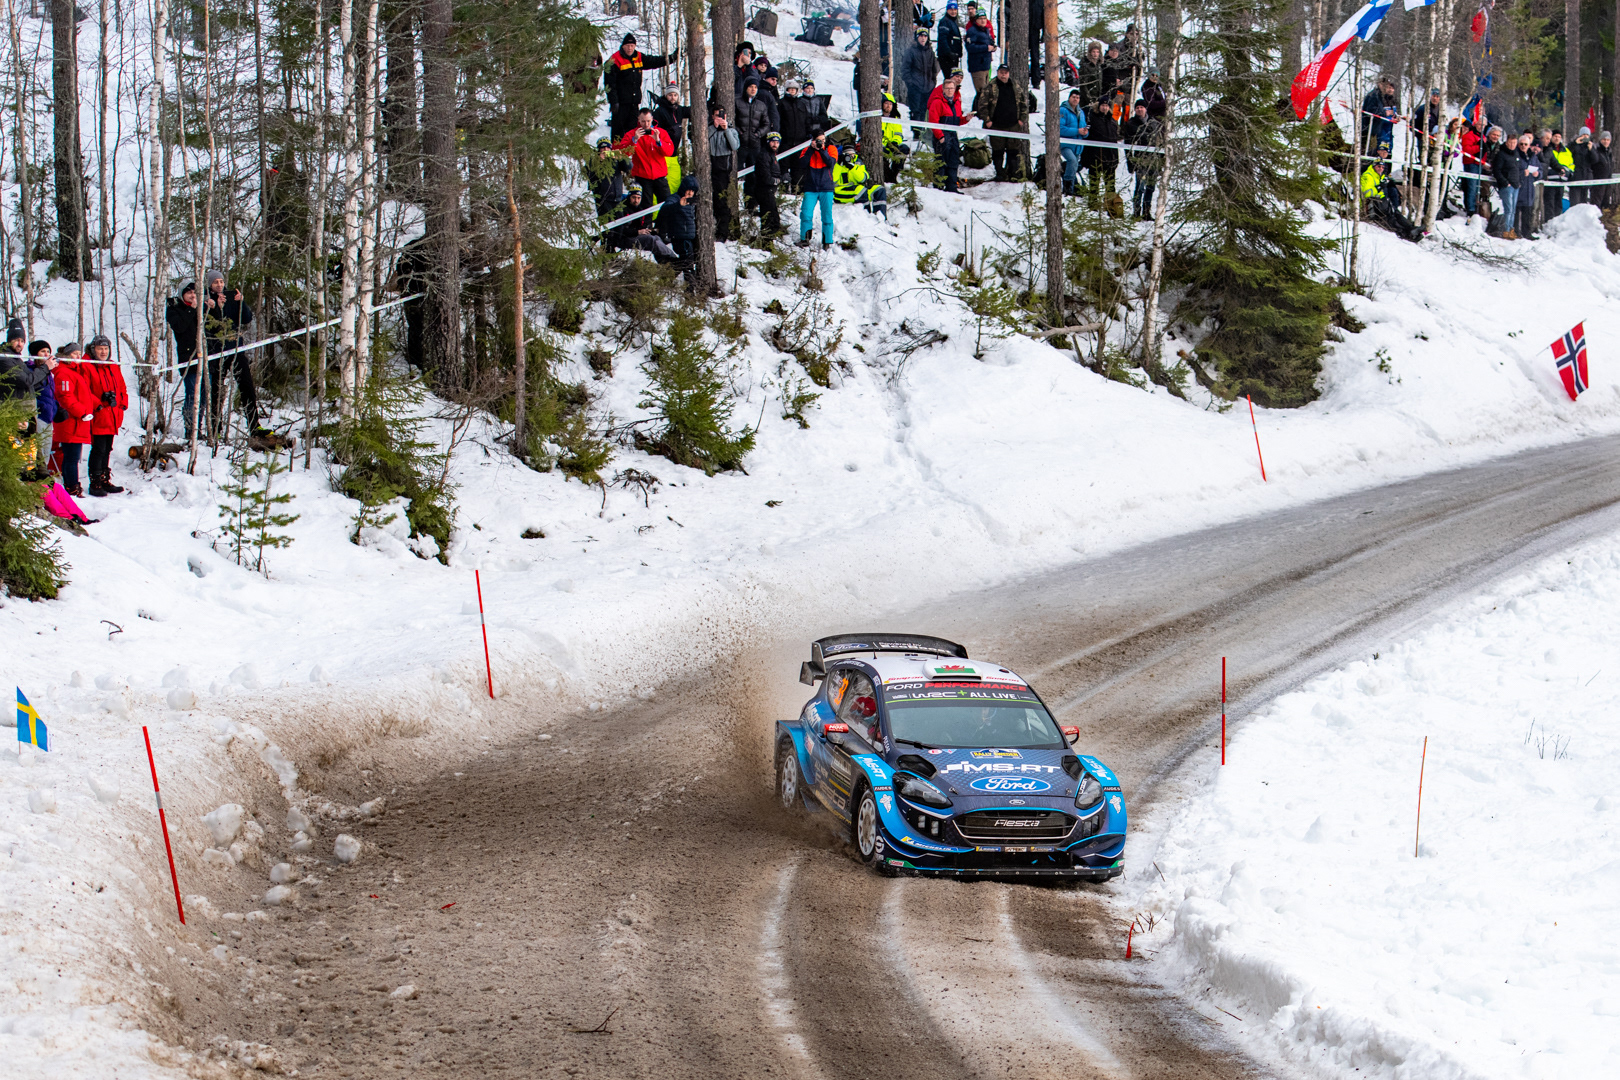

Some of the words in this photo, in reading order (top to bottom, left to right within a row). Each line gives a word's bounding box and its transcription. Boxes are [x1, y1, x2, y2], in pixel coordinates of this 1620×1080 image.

[886, 683, 923, 691] FORD
[924, 682, 1027, 691] PERFORMANCE
[964, 763, 1060, 773] MS-RT
[985, 777, 1037, 790] Ford
[994, 819, 1040, 827] Fiesta
